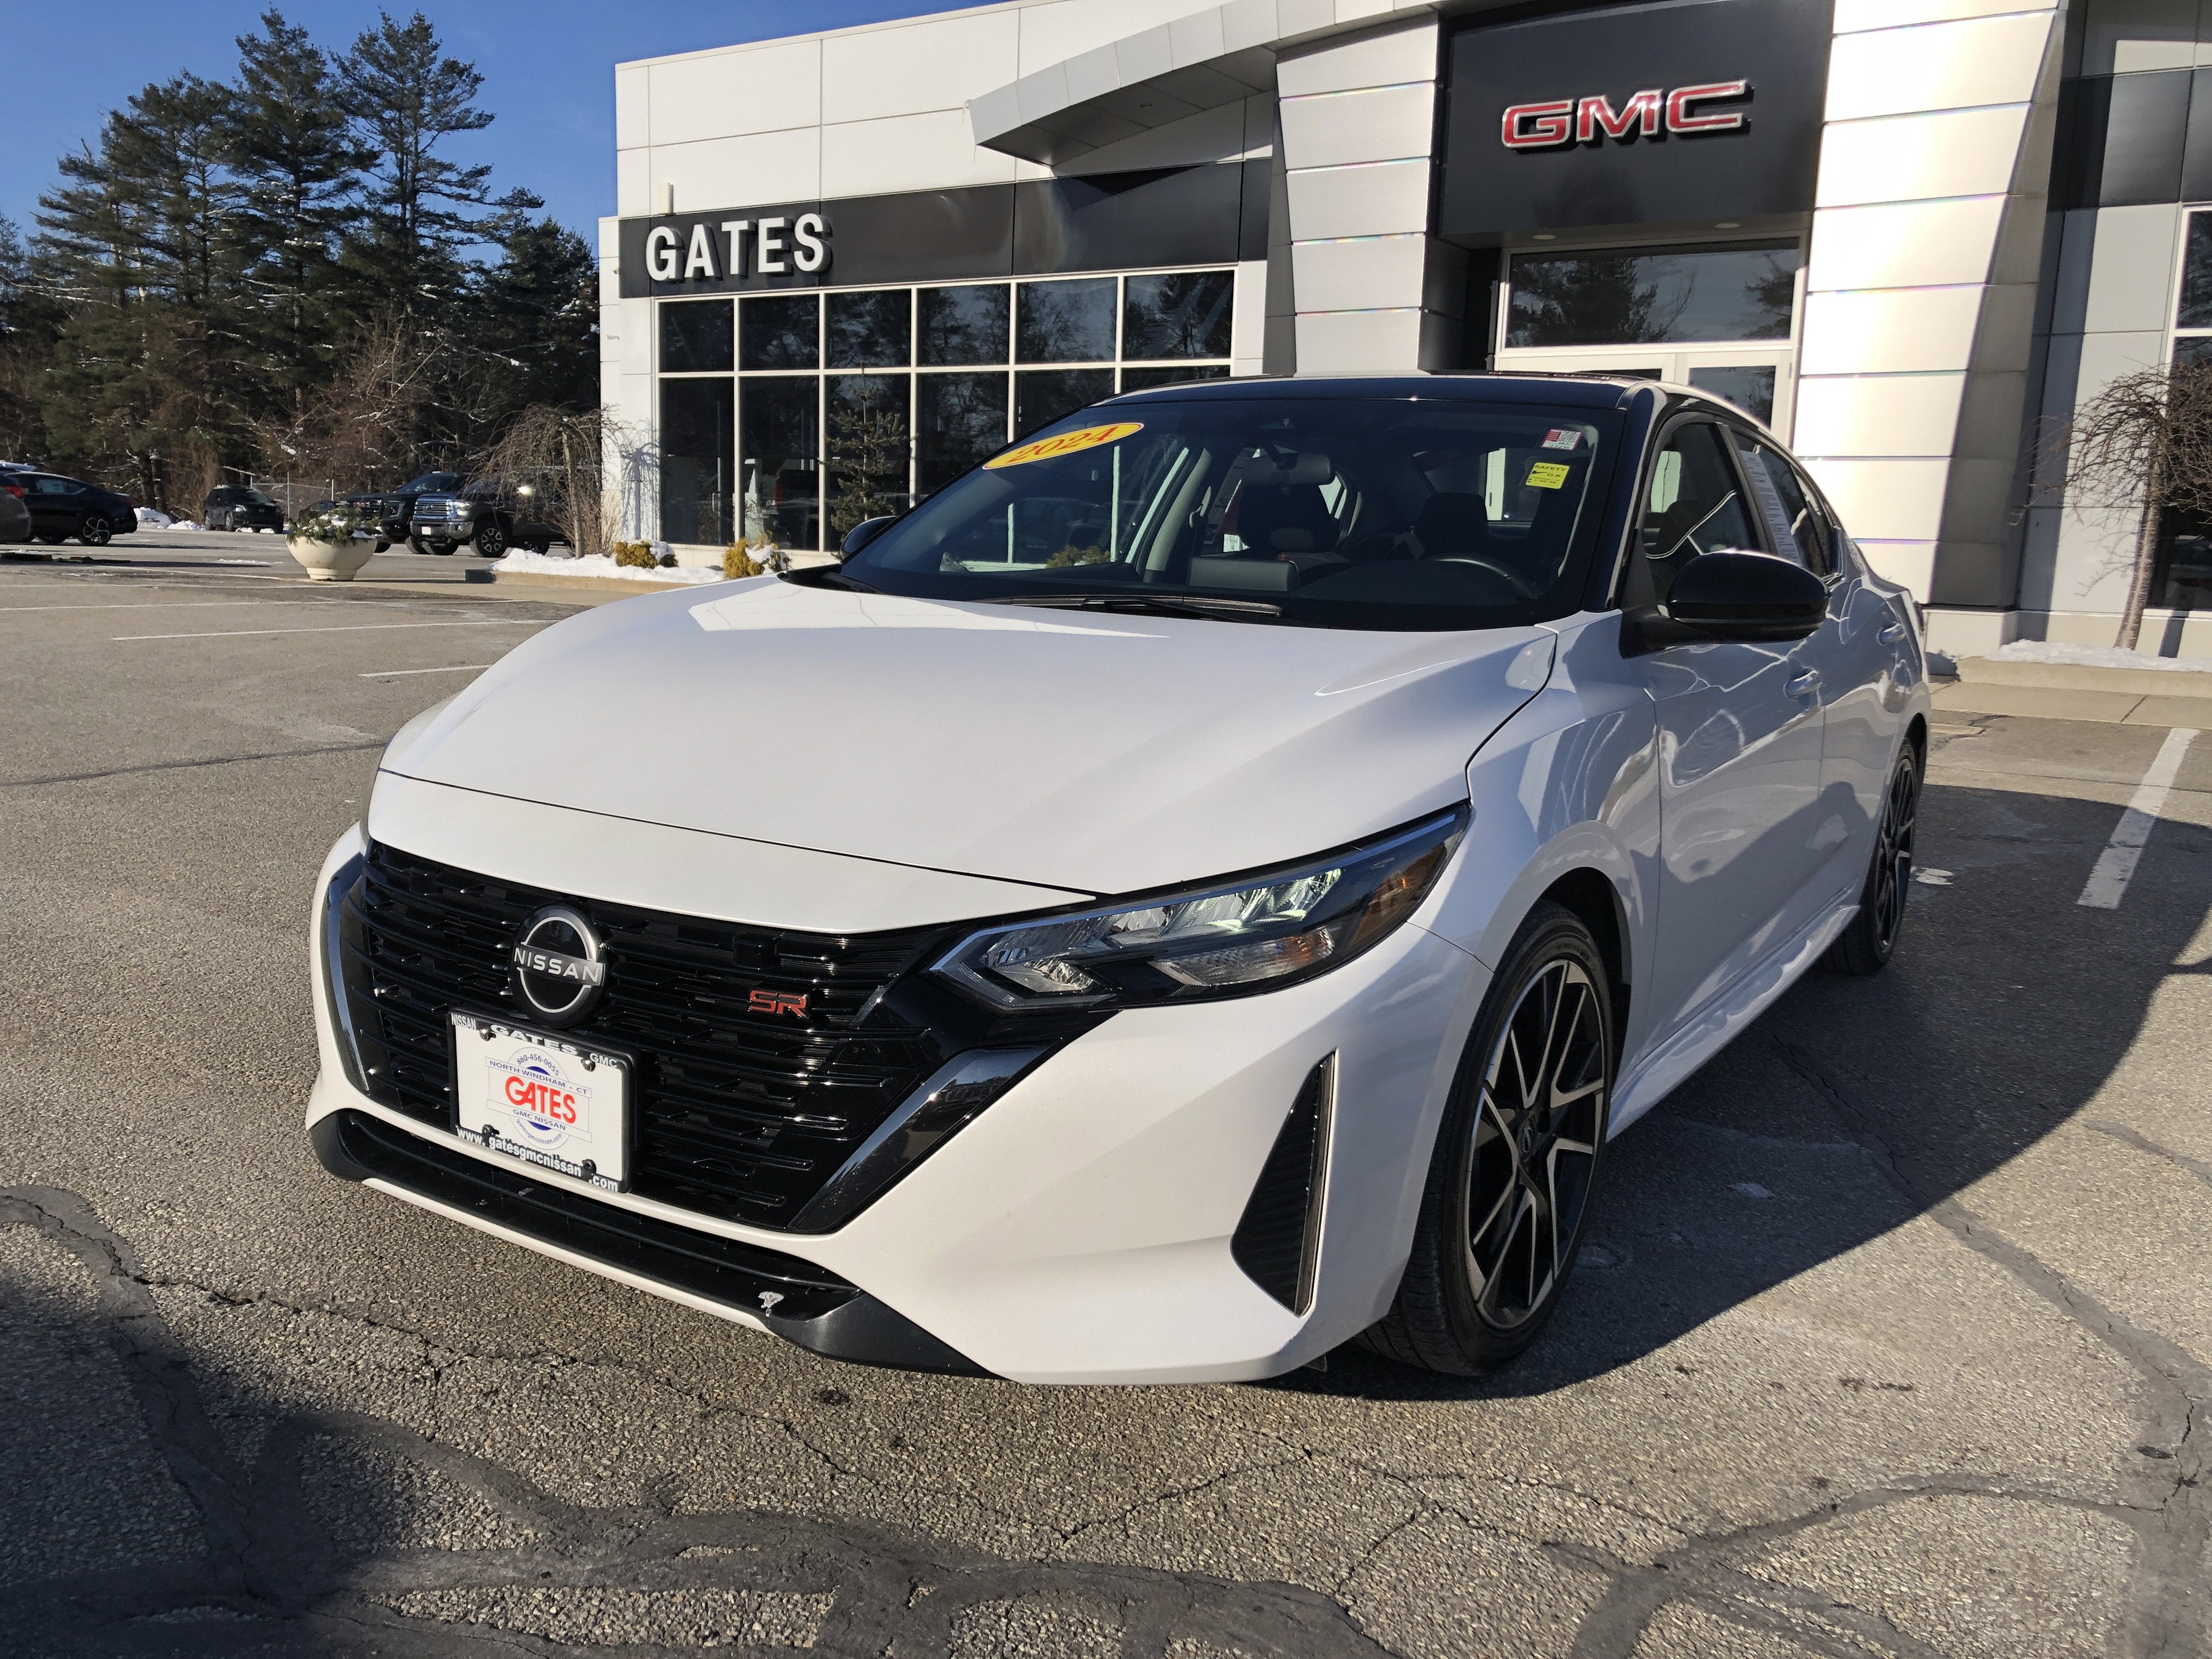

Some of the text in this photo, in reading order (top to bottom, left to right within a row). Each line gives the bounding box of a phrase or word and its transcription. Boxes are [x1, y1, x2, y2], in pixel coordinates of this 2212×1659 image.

[1502, 80, 1747, 148] GMC
[645, 213, 825, 281] GATES
[1005, 426, 1120, 464] 2024
[514, 947, 599, 983] NISSAN
[748, 990, 807, 1018] SR
[451, 1013, 617, 1068] NISSAN GATES GMC
[489, 1060, 588, 1095] NORTH WINDHAM CT
[516, 1053, 560, 1076] 860-456-0055
[505, 1076, 576, 1124] GATES
[513, 1109, 566, 1131] GMC NISSAN
[516, 1118, 562, 1144] gatesgmcnissan.com
